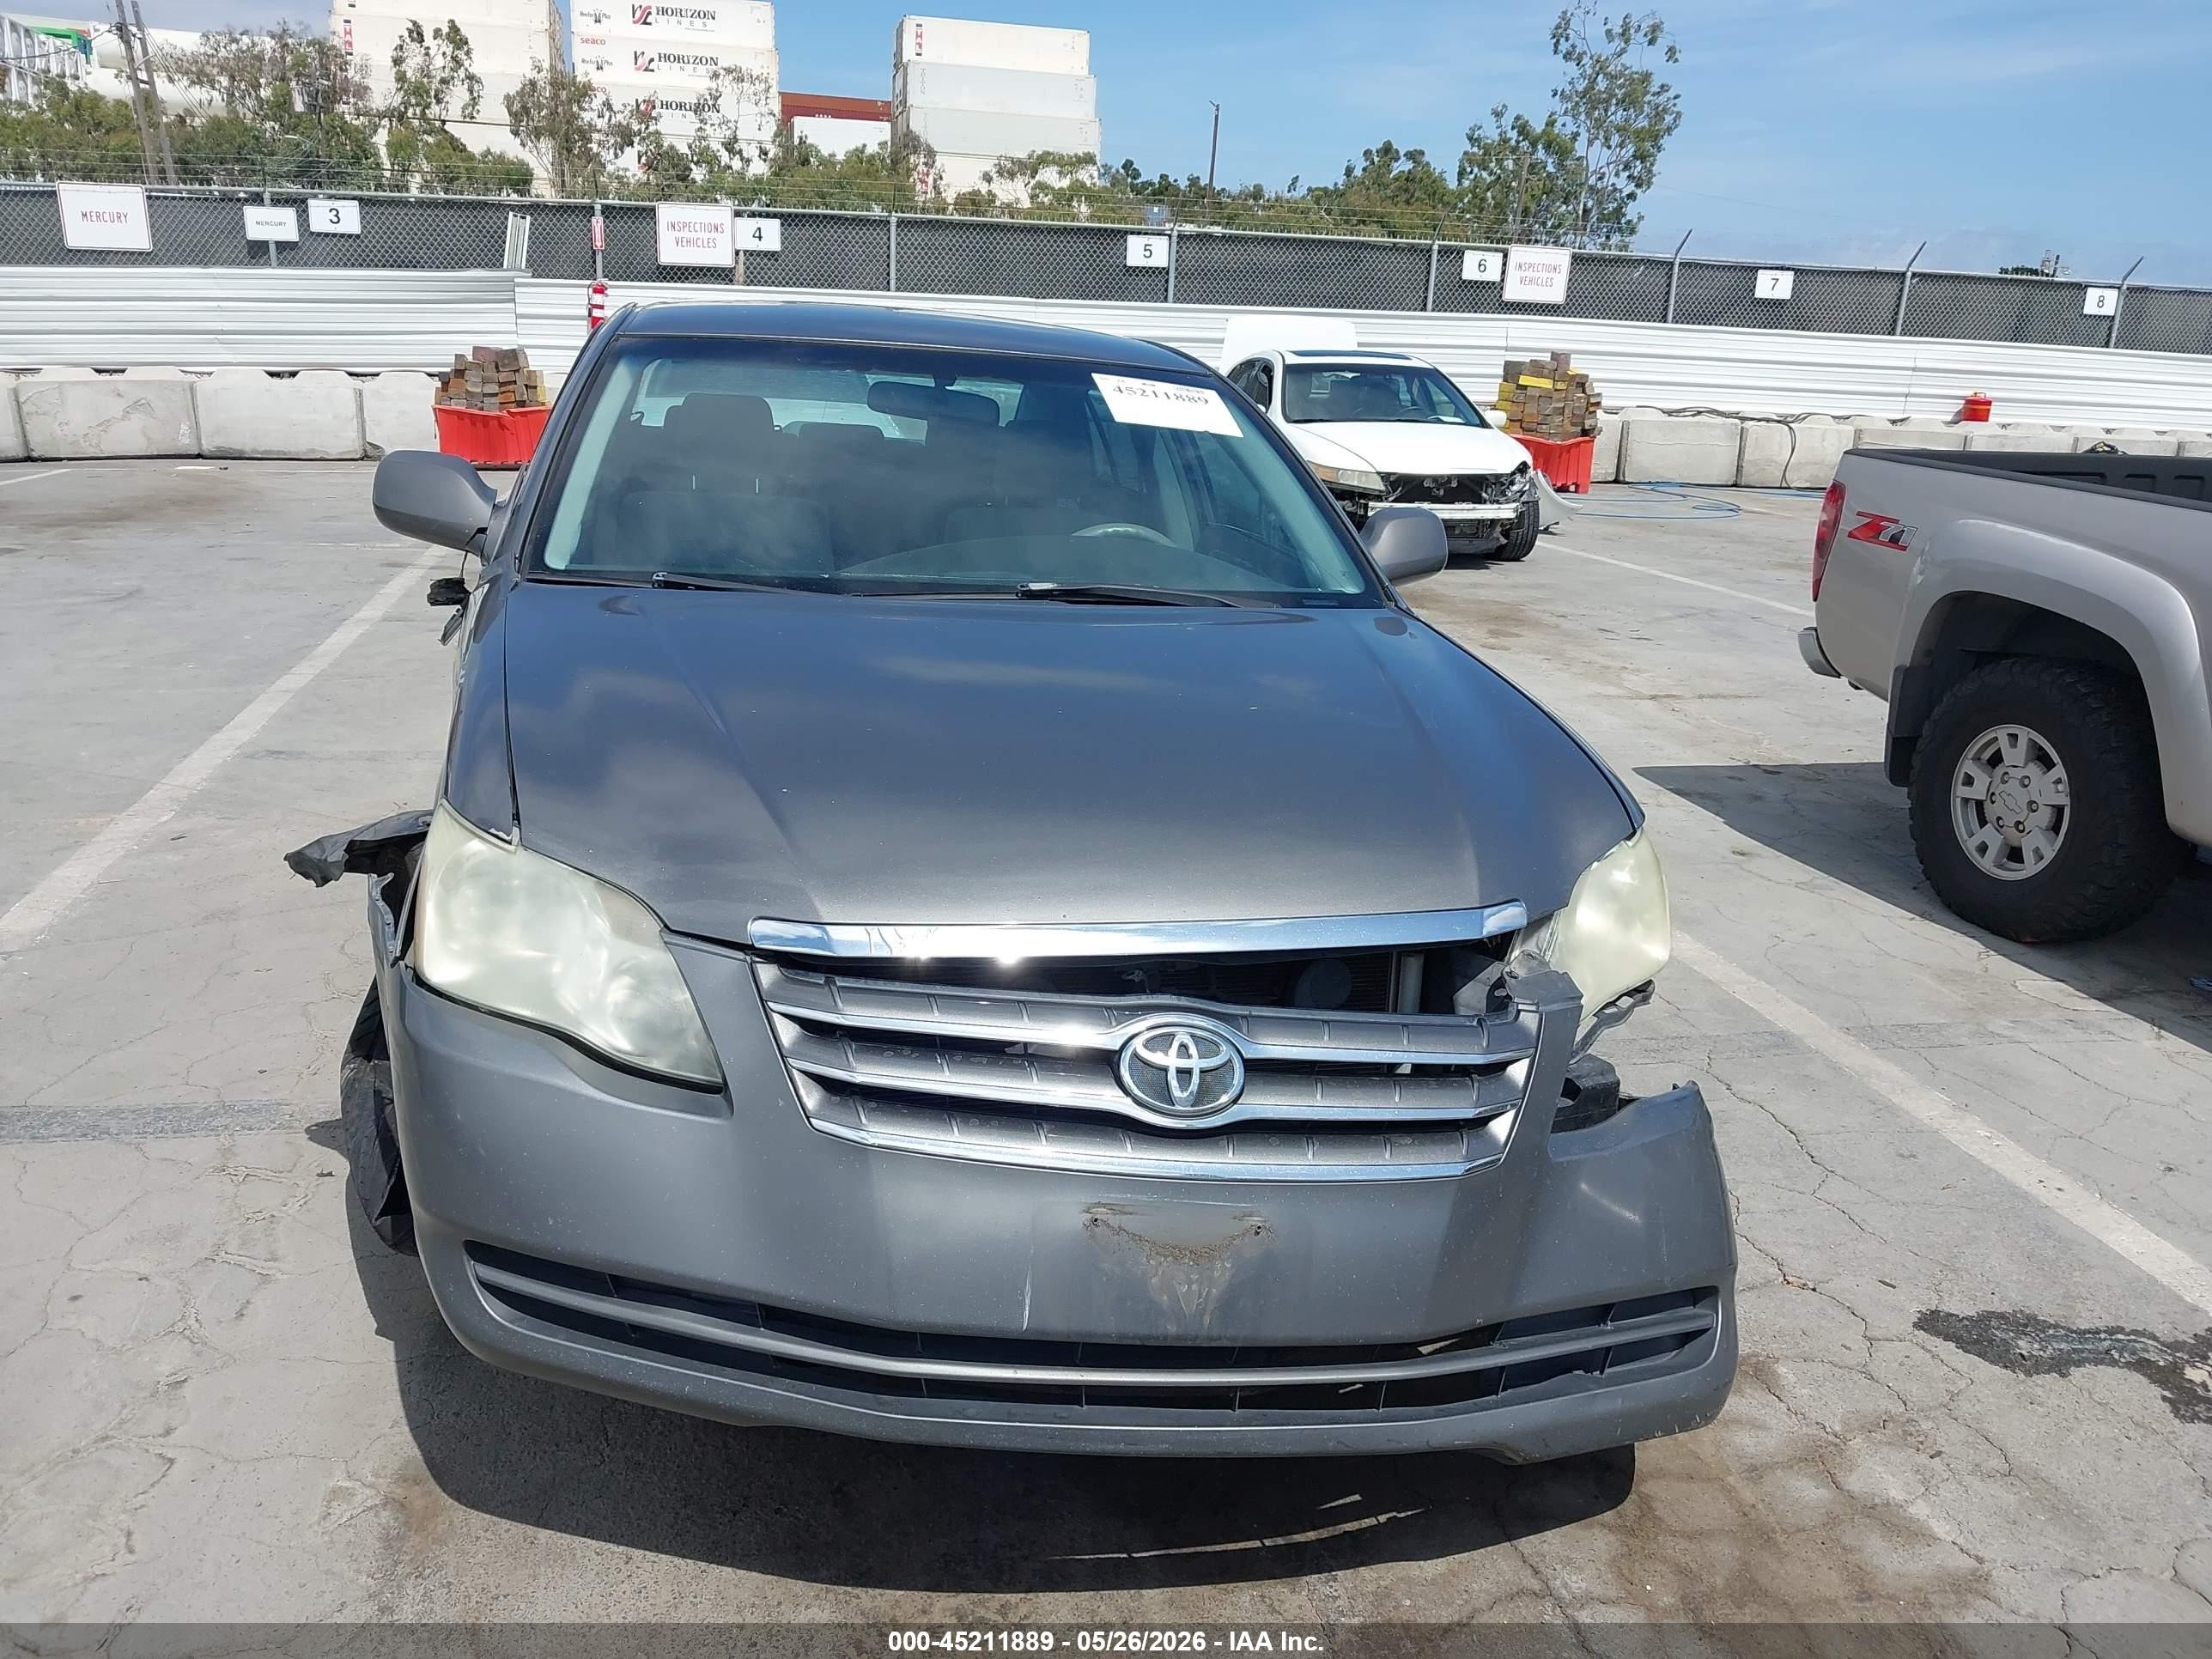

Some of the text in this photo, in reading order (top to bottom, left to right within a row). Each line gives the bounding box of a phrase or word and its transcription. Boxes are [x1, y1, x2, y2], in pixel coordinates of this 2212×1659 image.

[655, 6, 716, 21] HORIZON
[655, 19, 708, 28] LINES
[580, 37, 606, 46] seaco
[658, 52, 719, 66] HORIZON
[658, 64, 713, 75] LINES
[82, 210, 128, 223] MERCURY
[329, 208, 341, 224] 3
[666, 221, 725, 234] INSPECTIONS
[752, 227, 763, 241] 4
[675, 236, 717, 249] VEHICLES
[1143, 244, 1152, 258] 5
[1478, 258, 1487, 273] 6
[1515, 261, 1562, 275] INSPECTIONS
[1519, 275, 1554, 288] VEHICLES
[1771, 277, 1779, 290] 7
[2097, 295, 2105, 308] 8
[1113, 386, 1209, 405] 45211889
[1848, 511, 1917, 551] Z71
